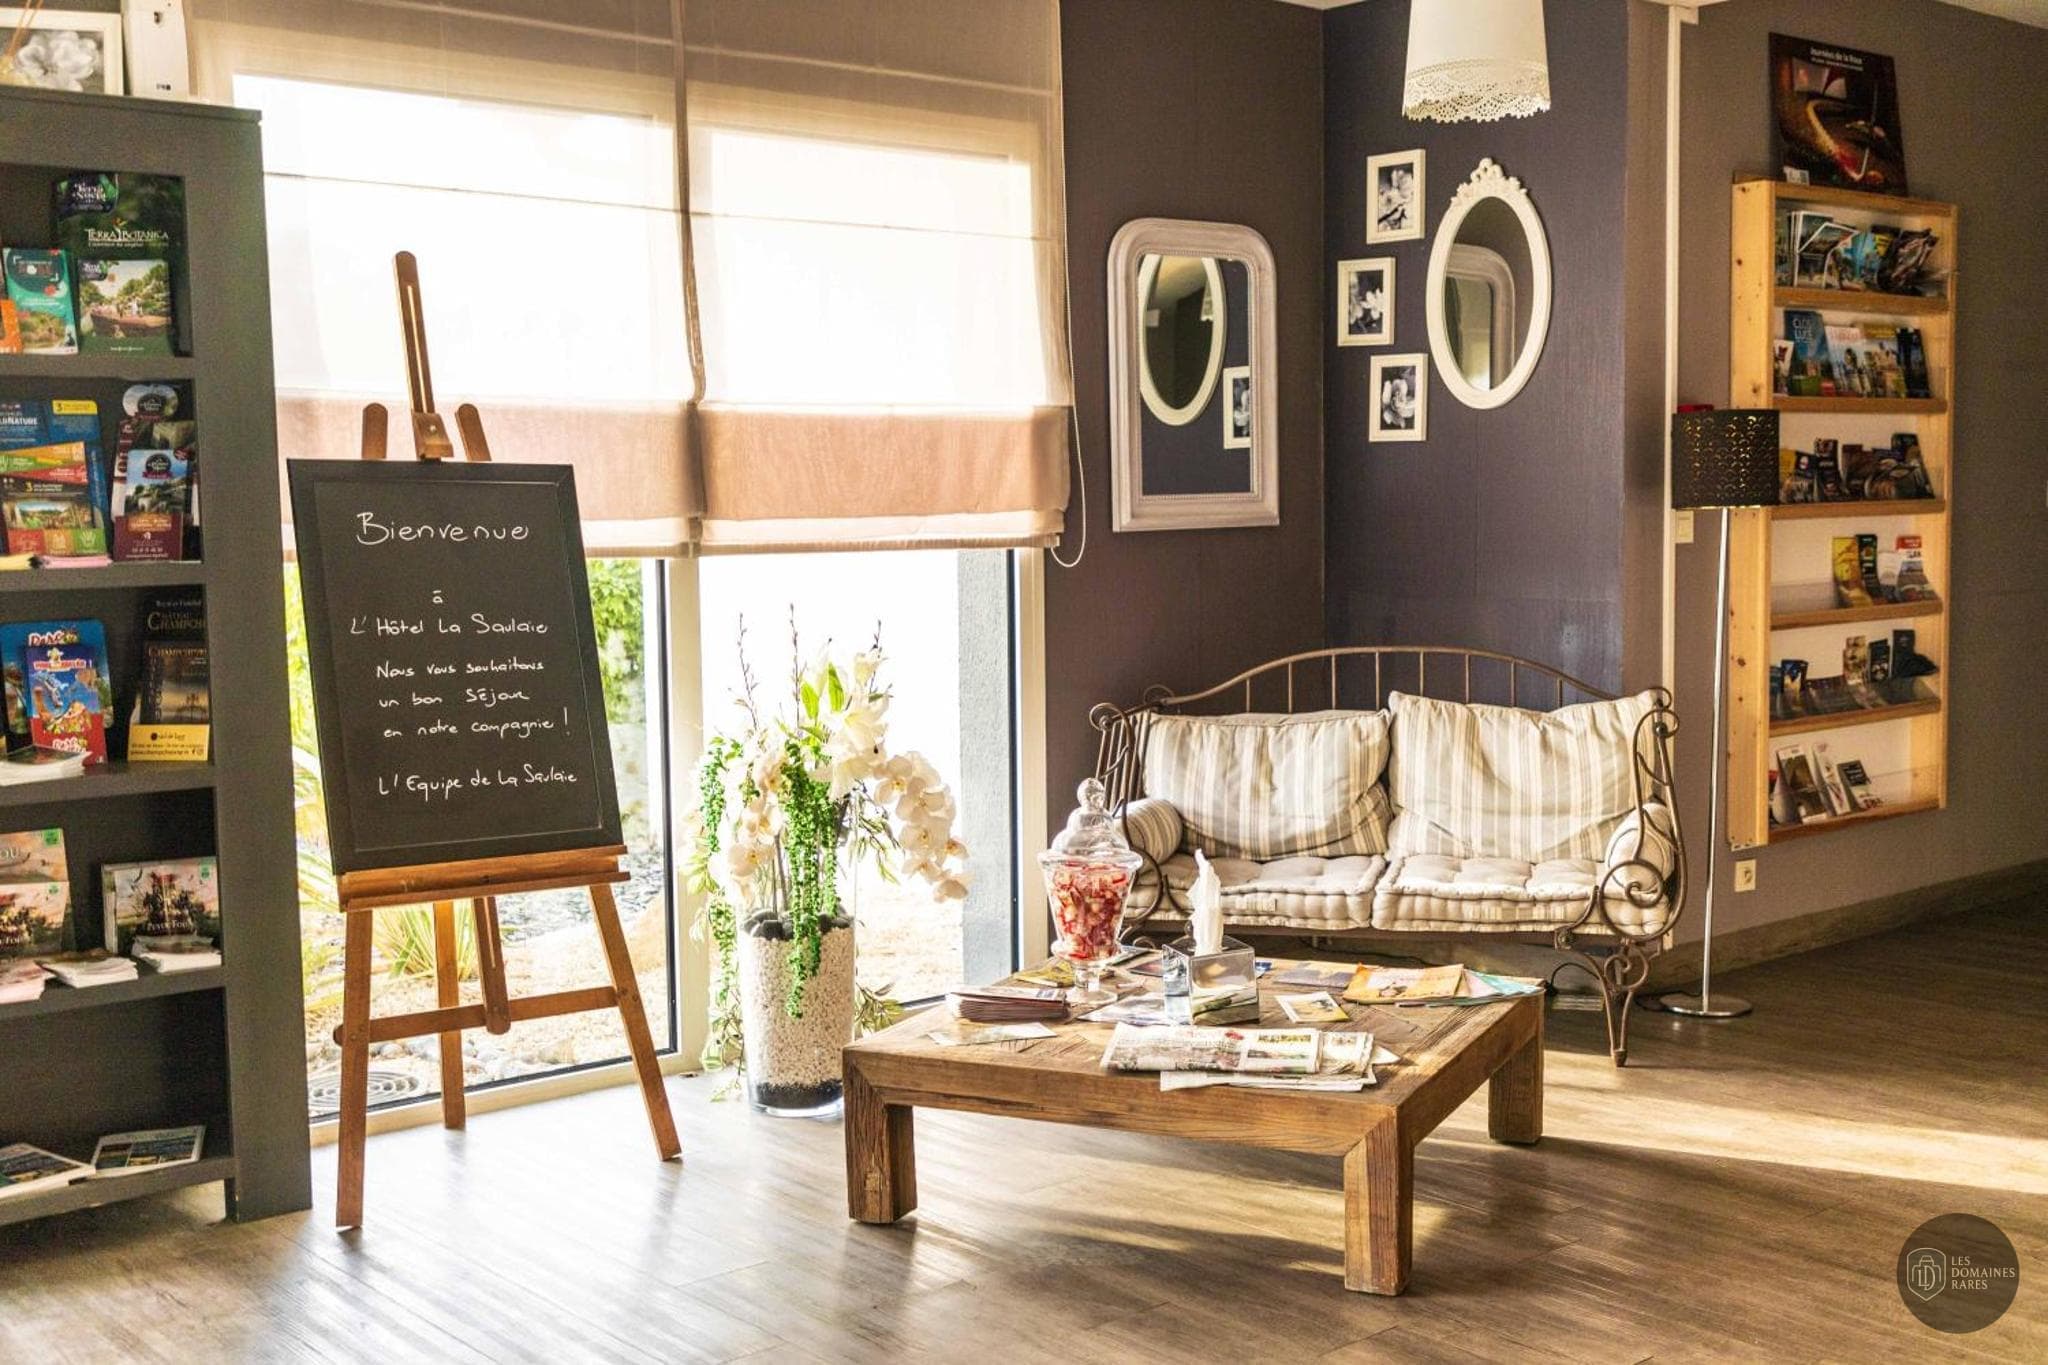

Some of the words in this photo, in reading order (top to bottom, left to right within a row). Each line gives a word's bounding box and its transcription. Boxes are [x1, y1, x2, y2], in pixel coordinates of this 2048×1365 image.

[356, 511, 529, 545] Bienvenue
[438, 618, 461, 634] La
[471, 613, 548, 634] Saulaie
[376, 661, 415, 678] Nous
[466, 656, 545, 674] souhaitons
[379, 699, 400, 708] un
[412, 692, 443, 705] bon
[383, 728, 402, 738] en
[417, 719, 458, 736] notre
[471, 718, 554, 739] compagnie
[470, 768, 491, 786] de
[498, 769, 518, 787] La
[524, 763, 577, 783] Saulaie
